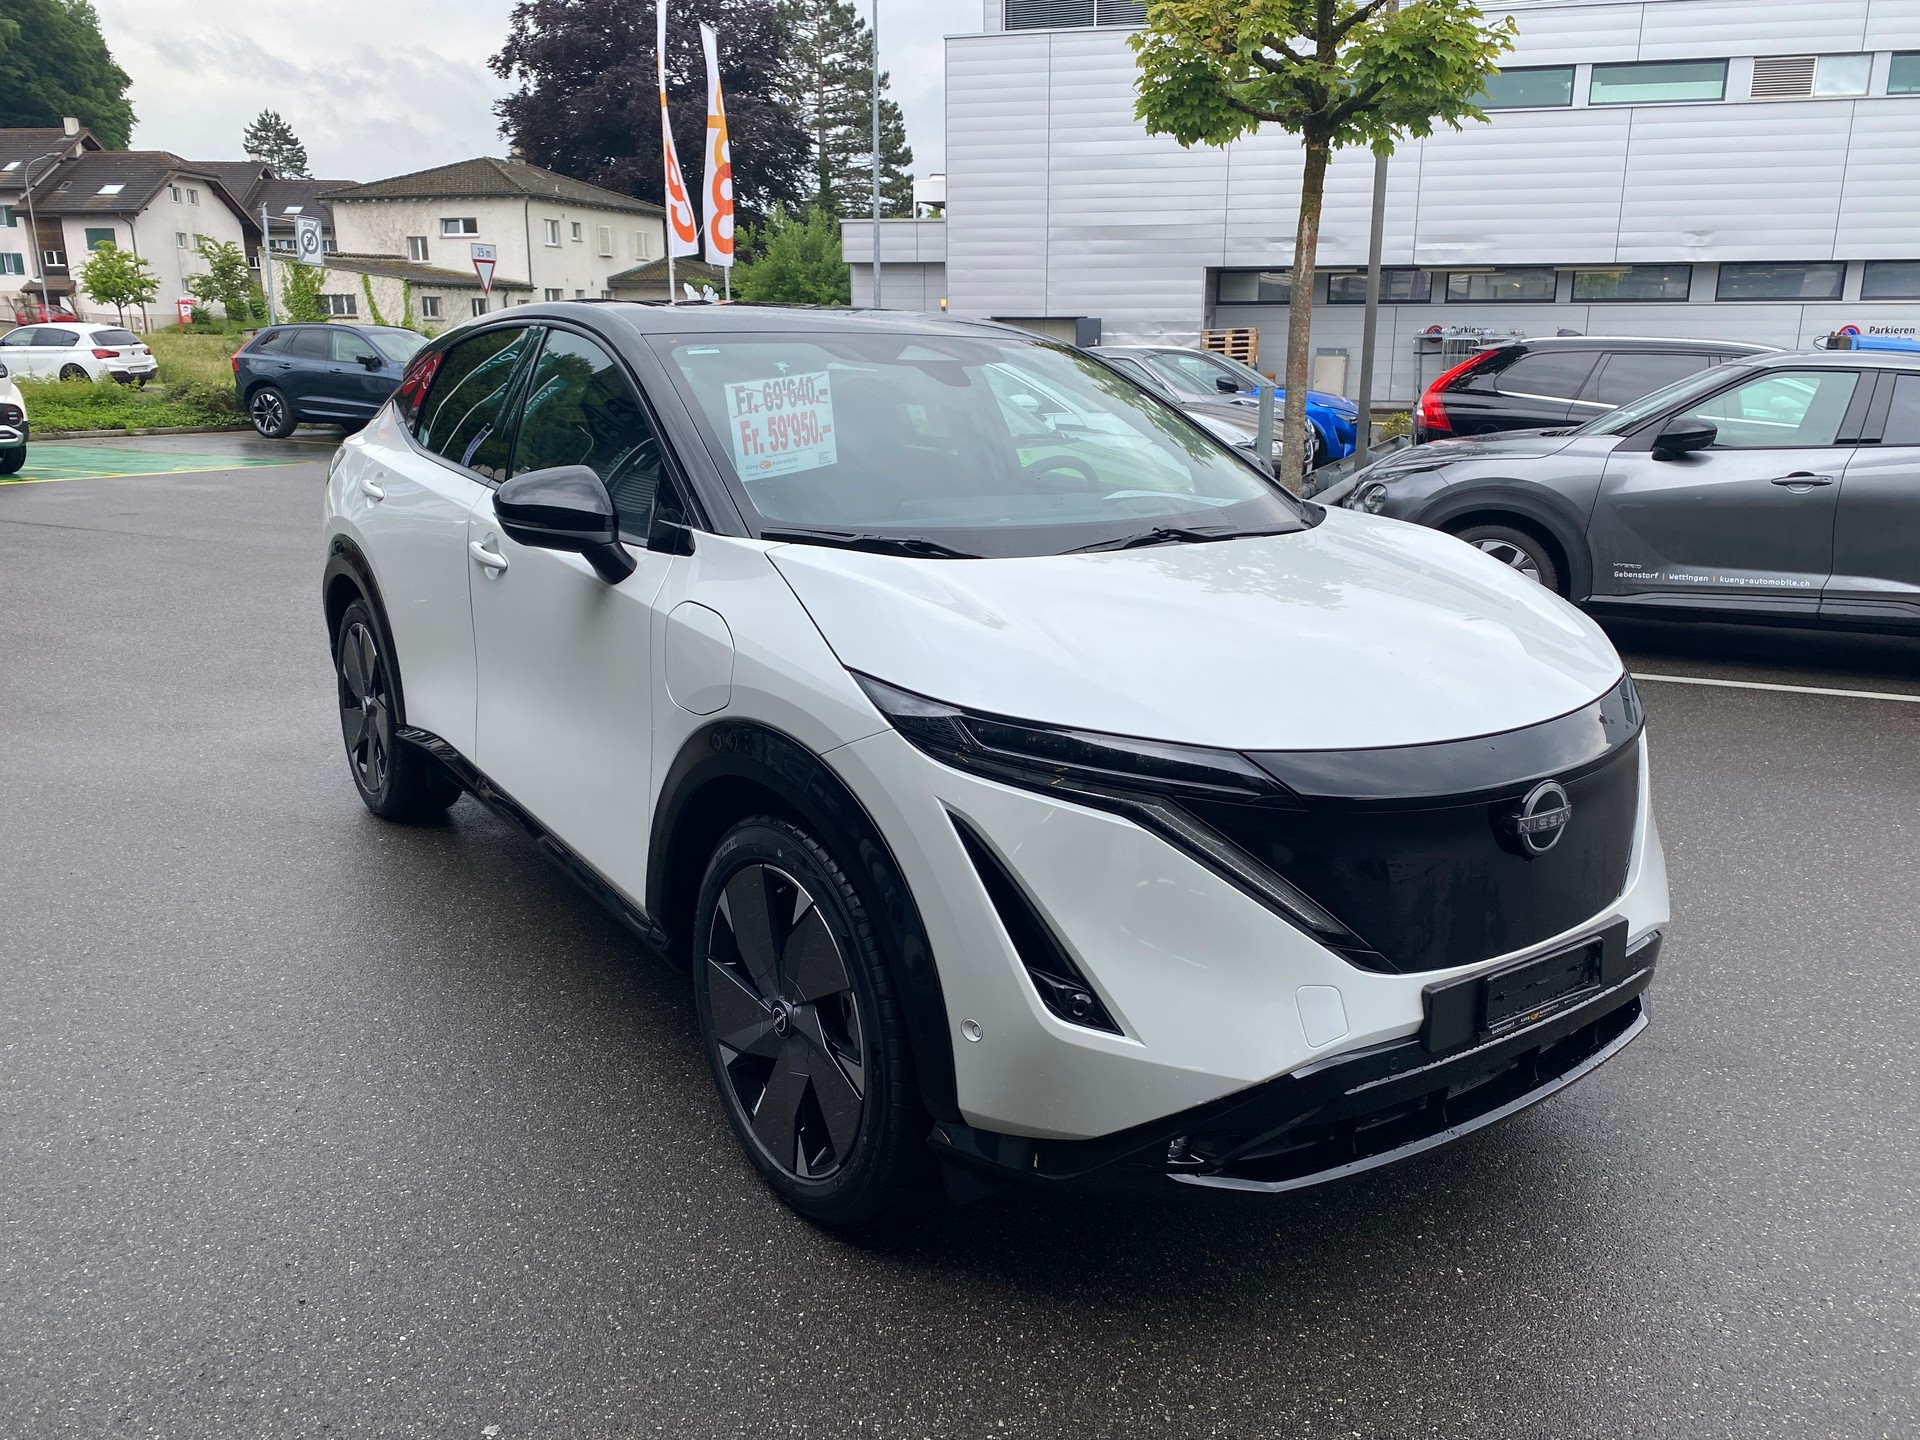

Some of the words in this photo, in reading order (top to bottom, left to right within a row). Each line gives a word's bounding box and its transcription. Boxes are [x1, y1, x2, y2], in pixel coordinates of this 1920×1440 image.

[477, 247, 485, 258] 25
[1869, 326, 1916, 334] Parkieren
[735, 385, 759, 414] Fr.
[740, 420, 765, 456] Fr.
[767, 410, 832, 452] 59'950.-
[1613, 570, 1660, 580] Gebenstorf
[1668, 573, 1709, 583] Wettingen
[1719, 575, 1811, 588] kueng-automobile.ch
[1519, 808, 1572, 833] NISSAN
